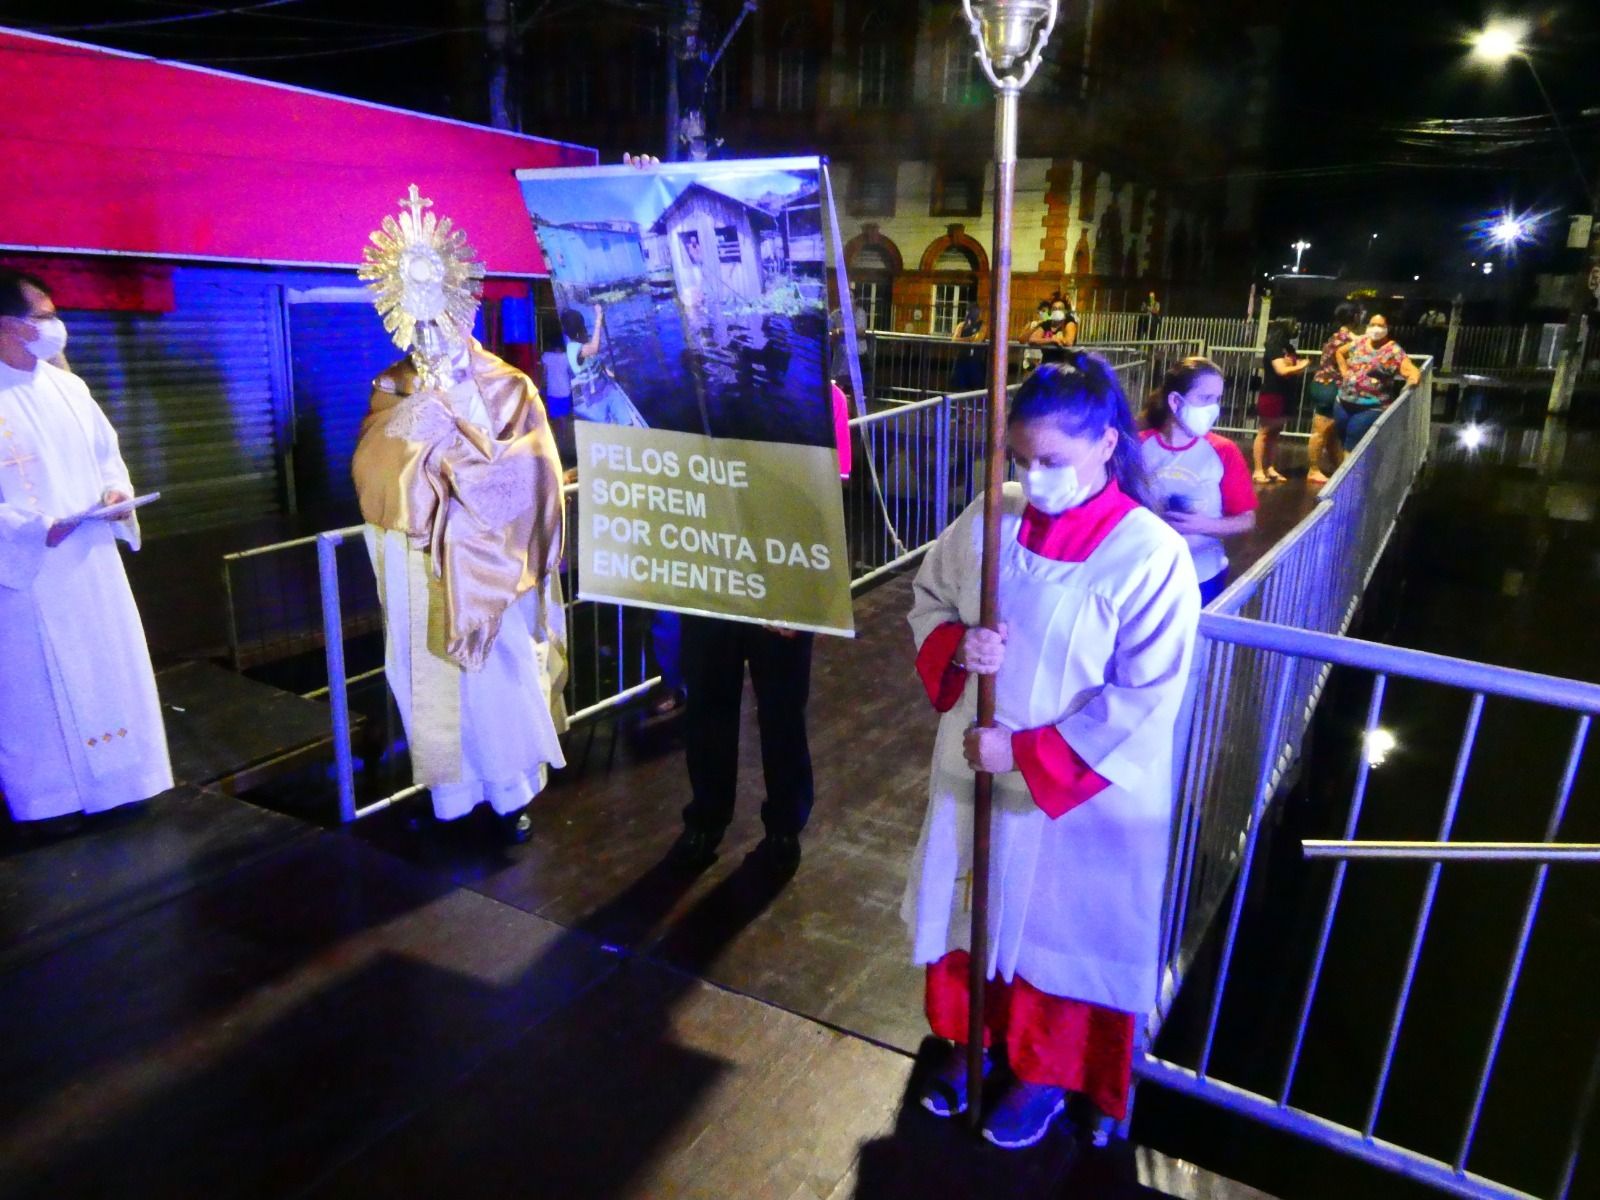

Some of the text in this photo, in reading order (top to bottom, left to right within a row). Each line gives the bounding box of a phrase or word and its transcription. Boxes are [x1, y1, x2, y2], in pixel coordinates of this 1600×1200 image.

[591, 443, 748, 488] PELOS QUE
[592, 479, 706, 519] SOFREM
[592, 514, 831, 571] POR CONTA DAS
[592, 551, 767, 599] ENCHENTES
